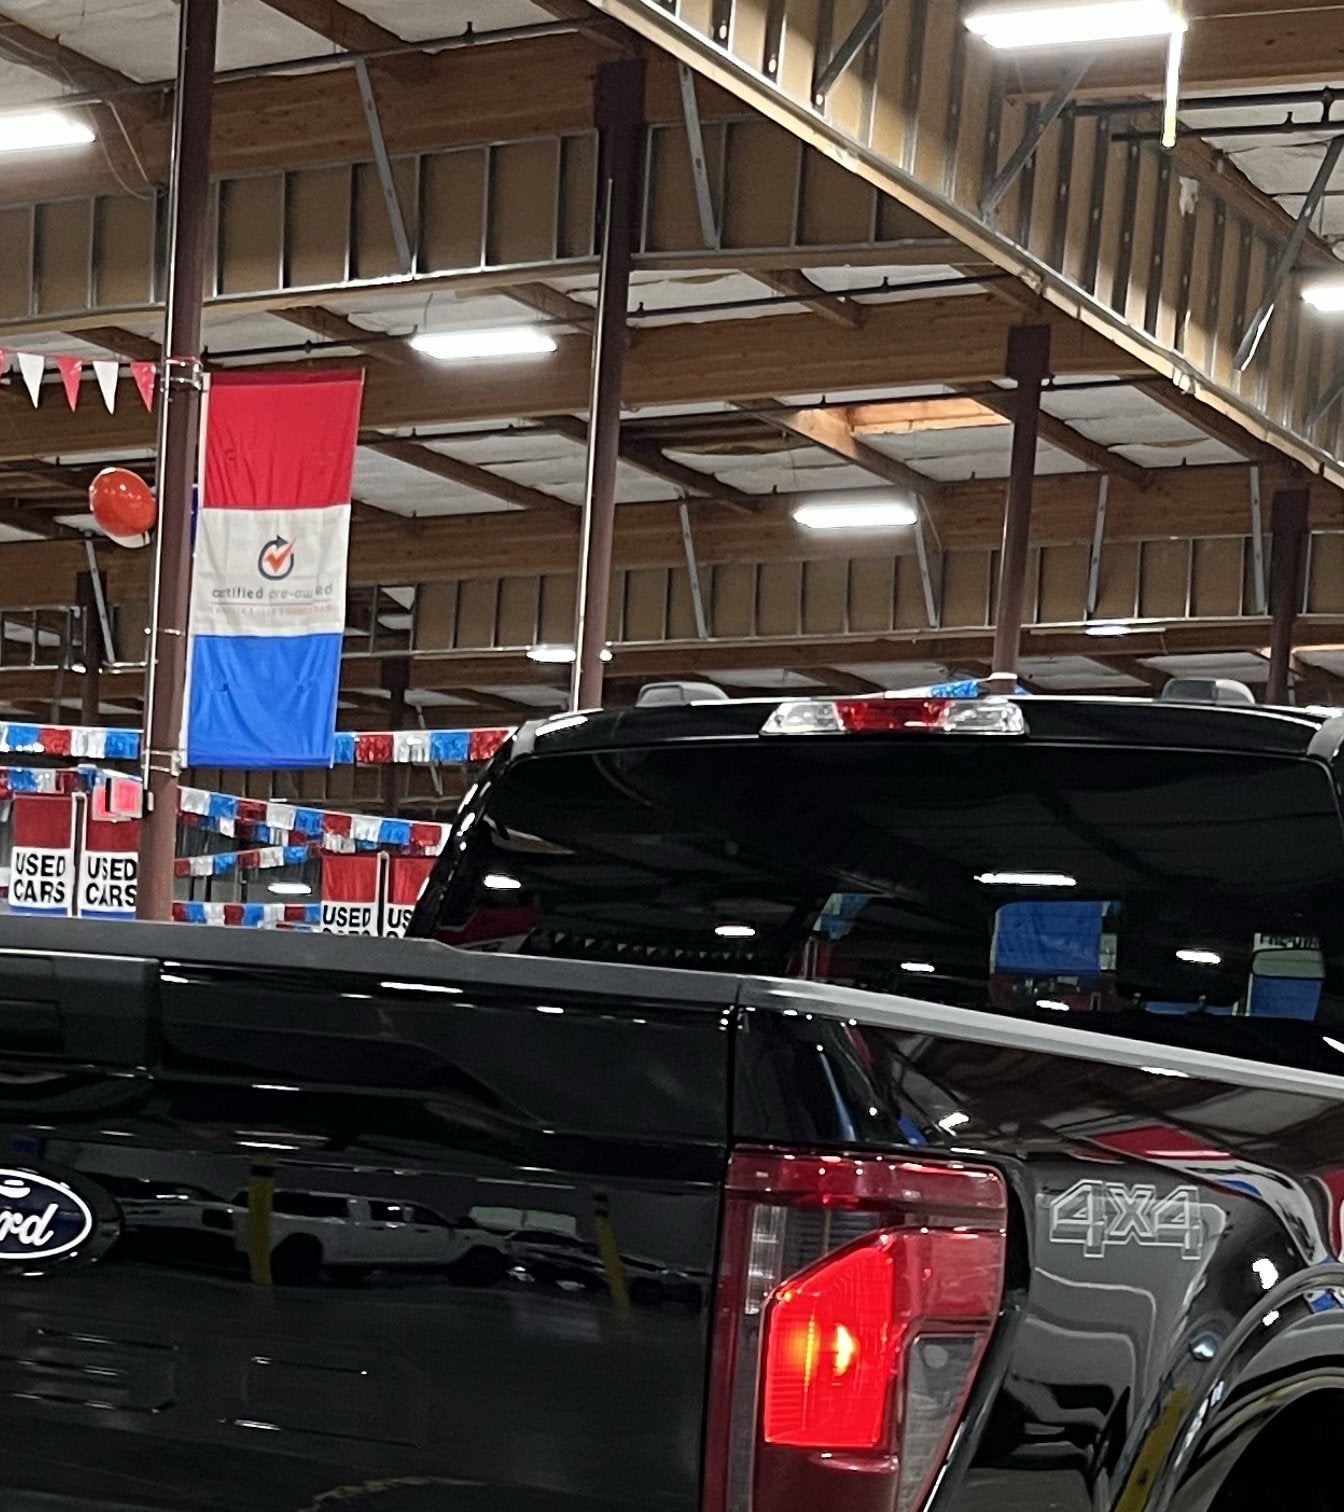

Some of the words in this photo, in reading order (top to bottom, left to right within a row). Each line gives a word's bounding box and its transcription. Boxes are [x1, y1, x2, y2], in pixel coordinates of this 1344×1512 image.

[16, 852, 66, 877] USED
[88, 856, 138, 881] USED
[14, 879, 65, 903] CARS
[85, 883, 137, 907] CARS
[323, 905, 371, 928] USED
[388, 908, 413, 930] US
